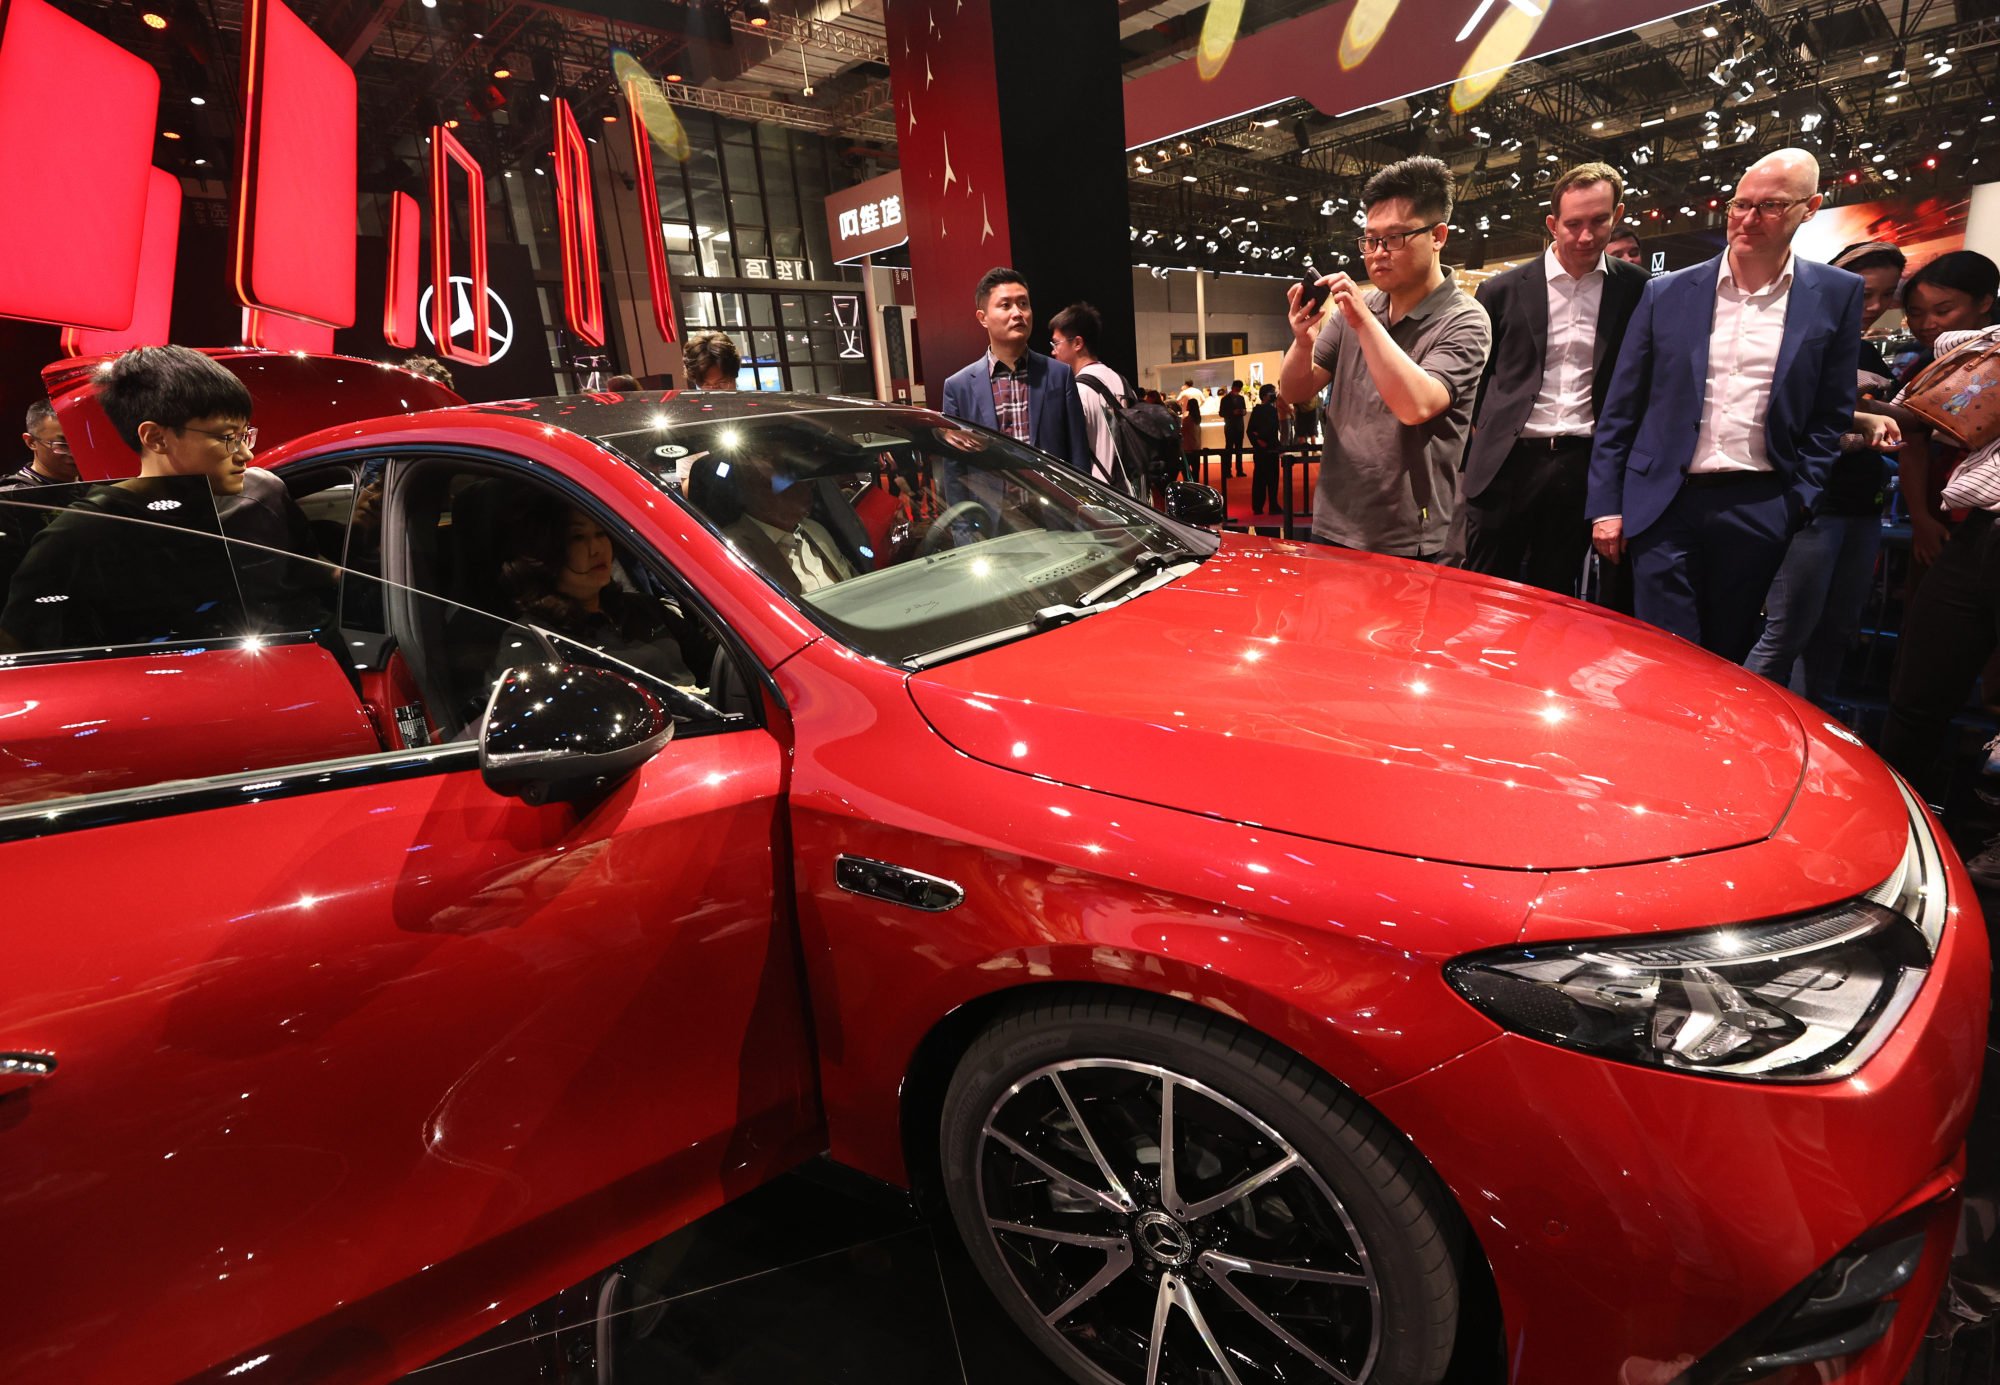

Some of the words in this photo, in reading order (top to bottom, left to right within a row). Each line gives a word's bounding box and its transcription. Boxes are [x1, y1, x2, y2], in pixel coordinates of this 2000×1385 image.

[839, 195, 901, 240] 阿维塔
[1008, 1036, 1064, 1060] TURANZA
